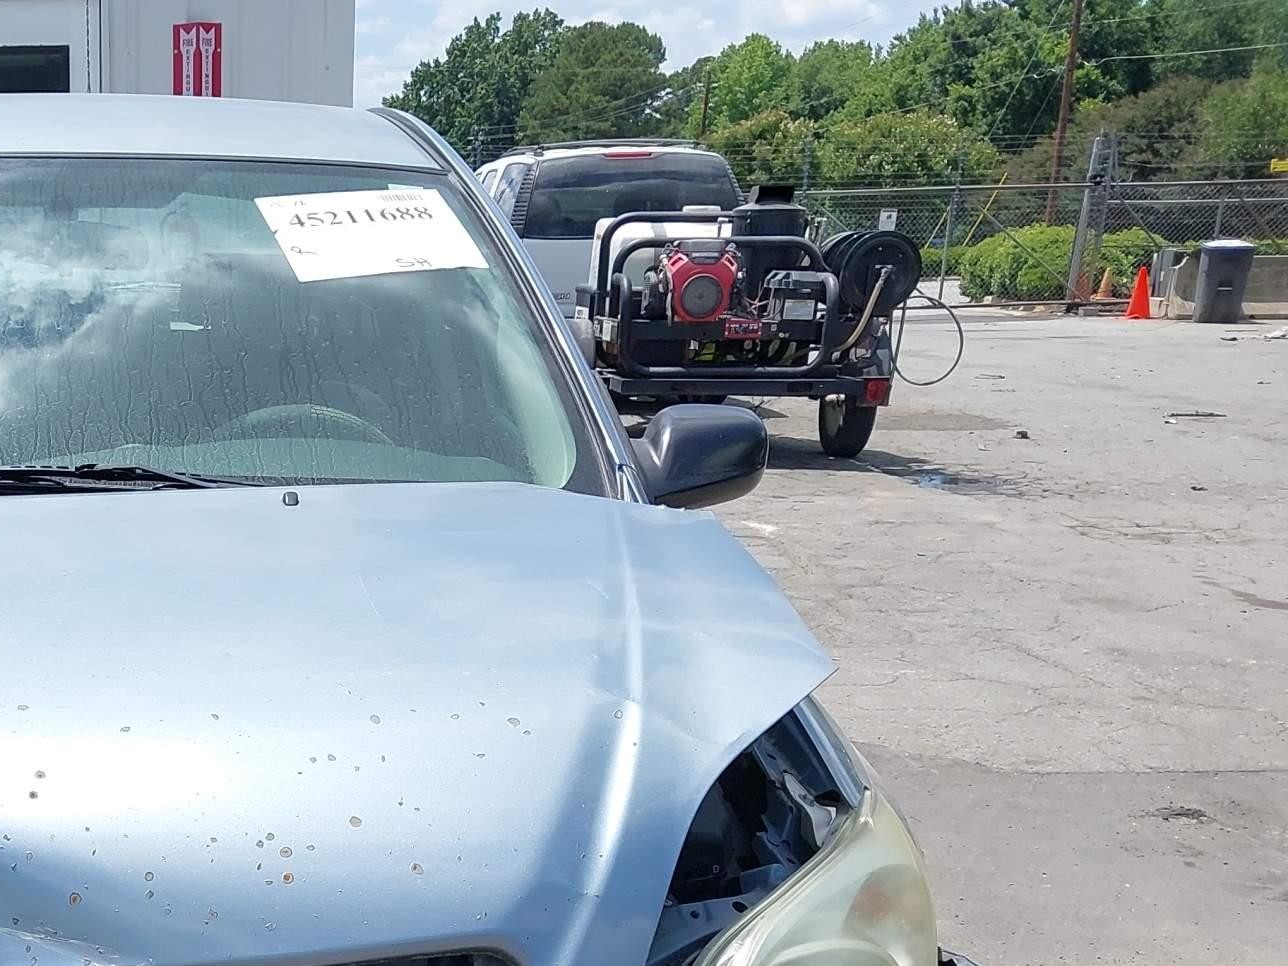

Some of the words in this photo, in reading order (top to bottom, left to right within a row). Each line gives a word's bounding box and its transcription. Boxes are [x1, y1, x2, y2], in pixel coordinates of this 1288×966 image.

[182, 38, 194, 47] FIRE
[201, 38, 213, 47] FIRE
[289, 206, 434, 228] 45211688
